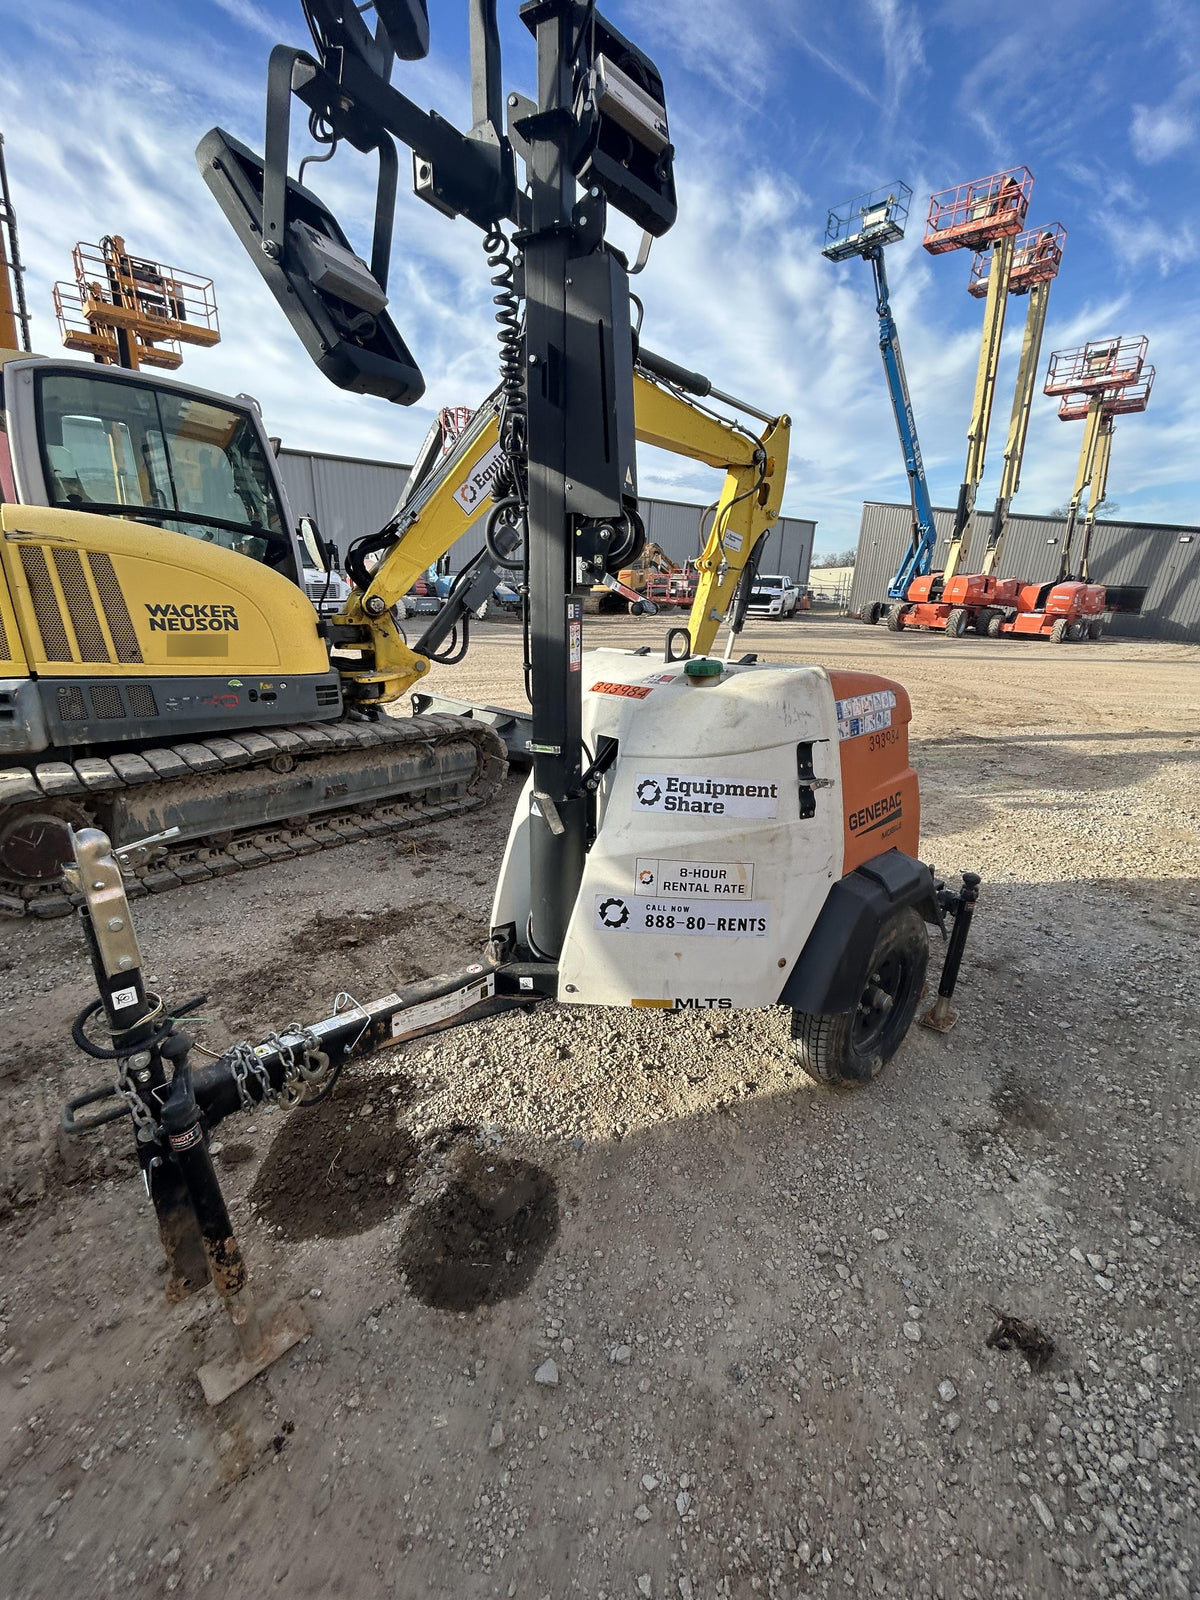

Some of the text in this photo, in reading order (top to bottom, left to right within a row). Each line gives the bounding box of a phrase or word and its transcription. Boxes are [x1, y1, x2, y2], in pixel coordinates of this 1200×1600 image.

[144, 603, 238, 618] WACKER
[149, 618, 239, 631] NEUSON
[591, 681, 651, 698] 393984
[666, 777, 778, 799] Equipment
[664, 795, 725, 814] Share
[849, 791, 902, 831] GENERAC
[679, 868, 727, 879] 8-HOUR
[663, 881, 745, 894] RENTAL RATE
[645, 904, 690, 913] CALL NOW
[645, 914, 766, 932] 888-80-RENTS
[675, 998, 732, 1009] MLTS
